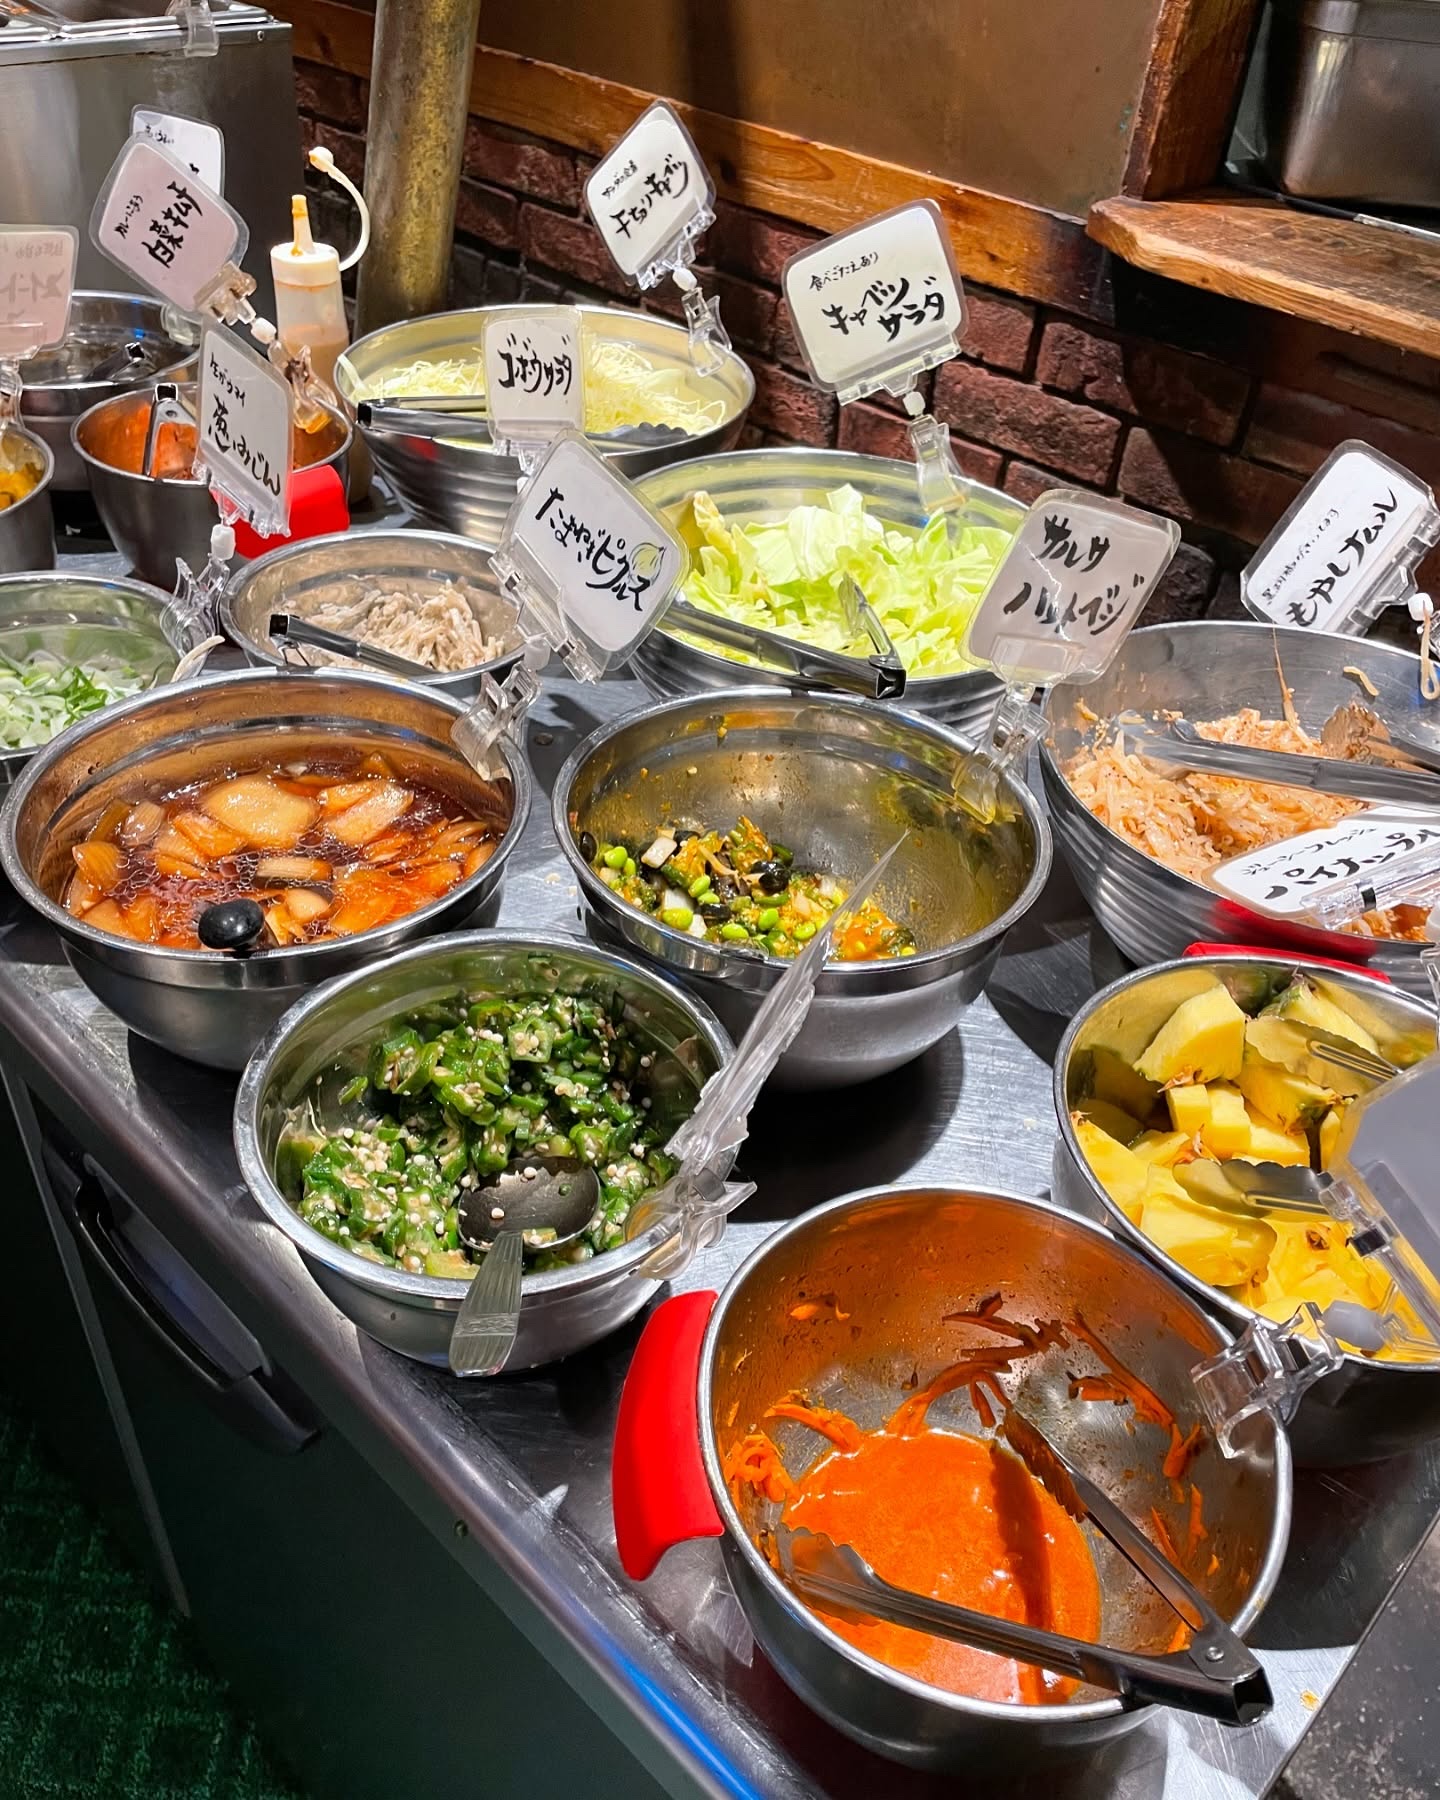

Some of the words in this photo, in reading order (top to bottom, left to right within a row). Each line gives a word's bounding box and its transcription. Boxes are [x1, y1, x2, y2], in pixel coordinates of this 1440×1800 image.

[809, 251, 879, 292] 食べごたえあり
[821, 277, 910, 336] キャベツ
[877, 276, 945, 343] サラダ
[497, 333, 573, 396] ゴボウサラダ
[535, 487, 651, 612] たまねぎピクルス
[1032, 514, 1111, 573] サルサ
[1286, 486, 1398, 628] もやしナムル
